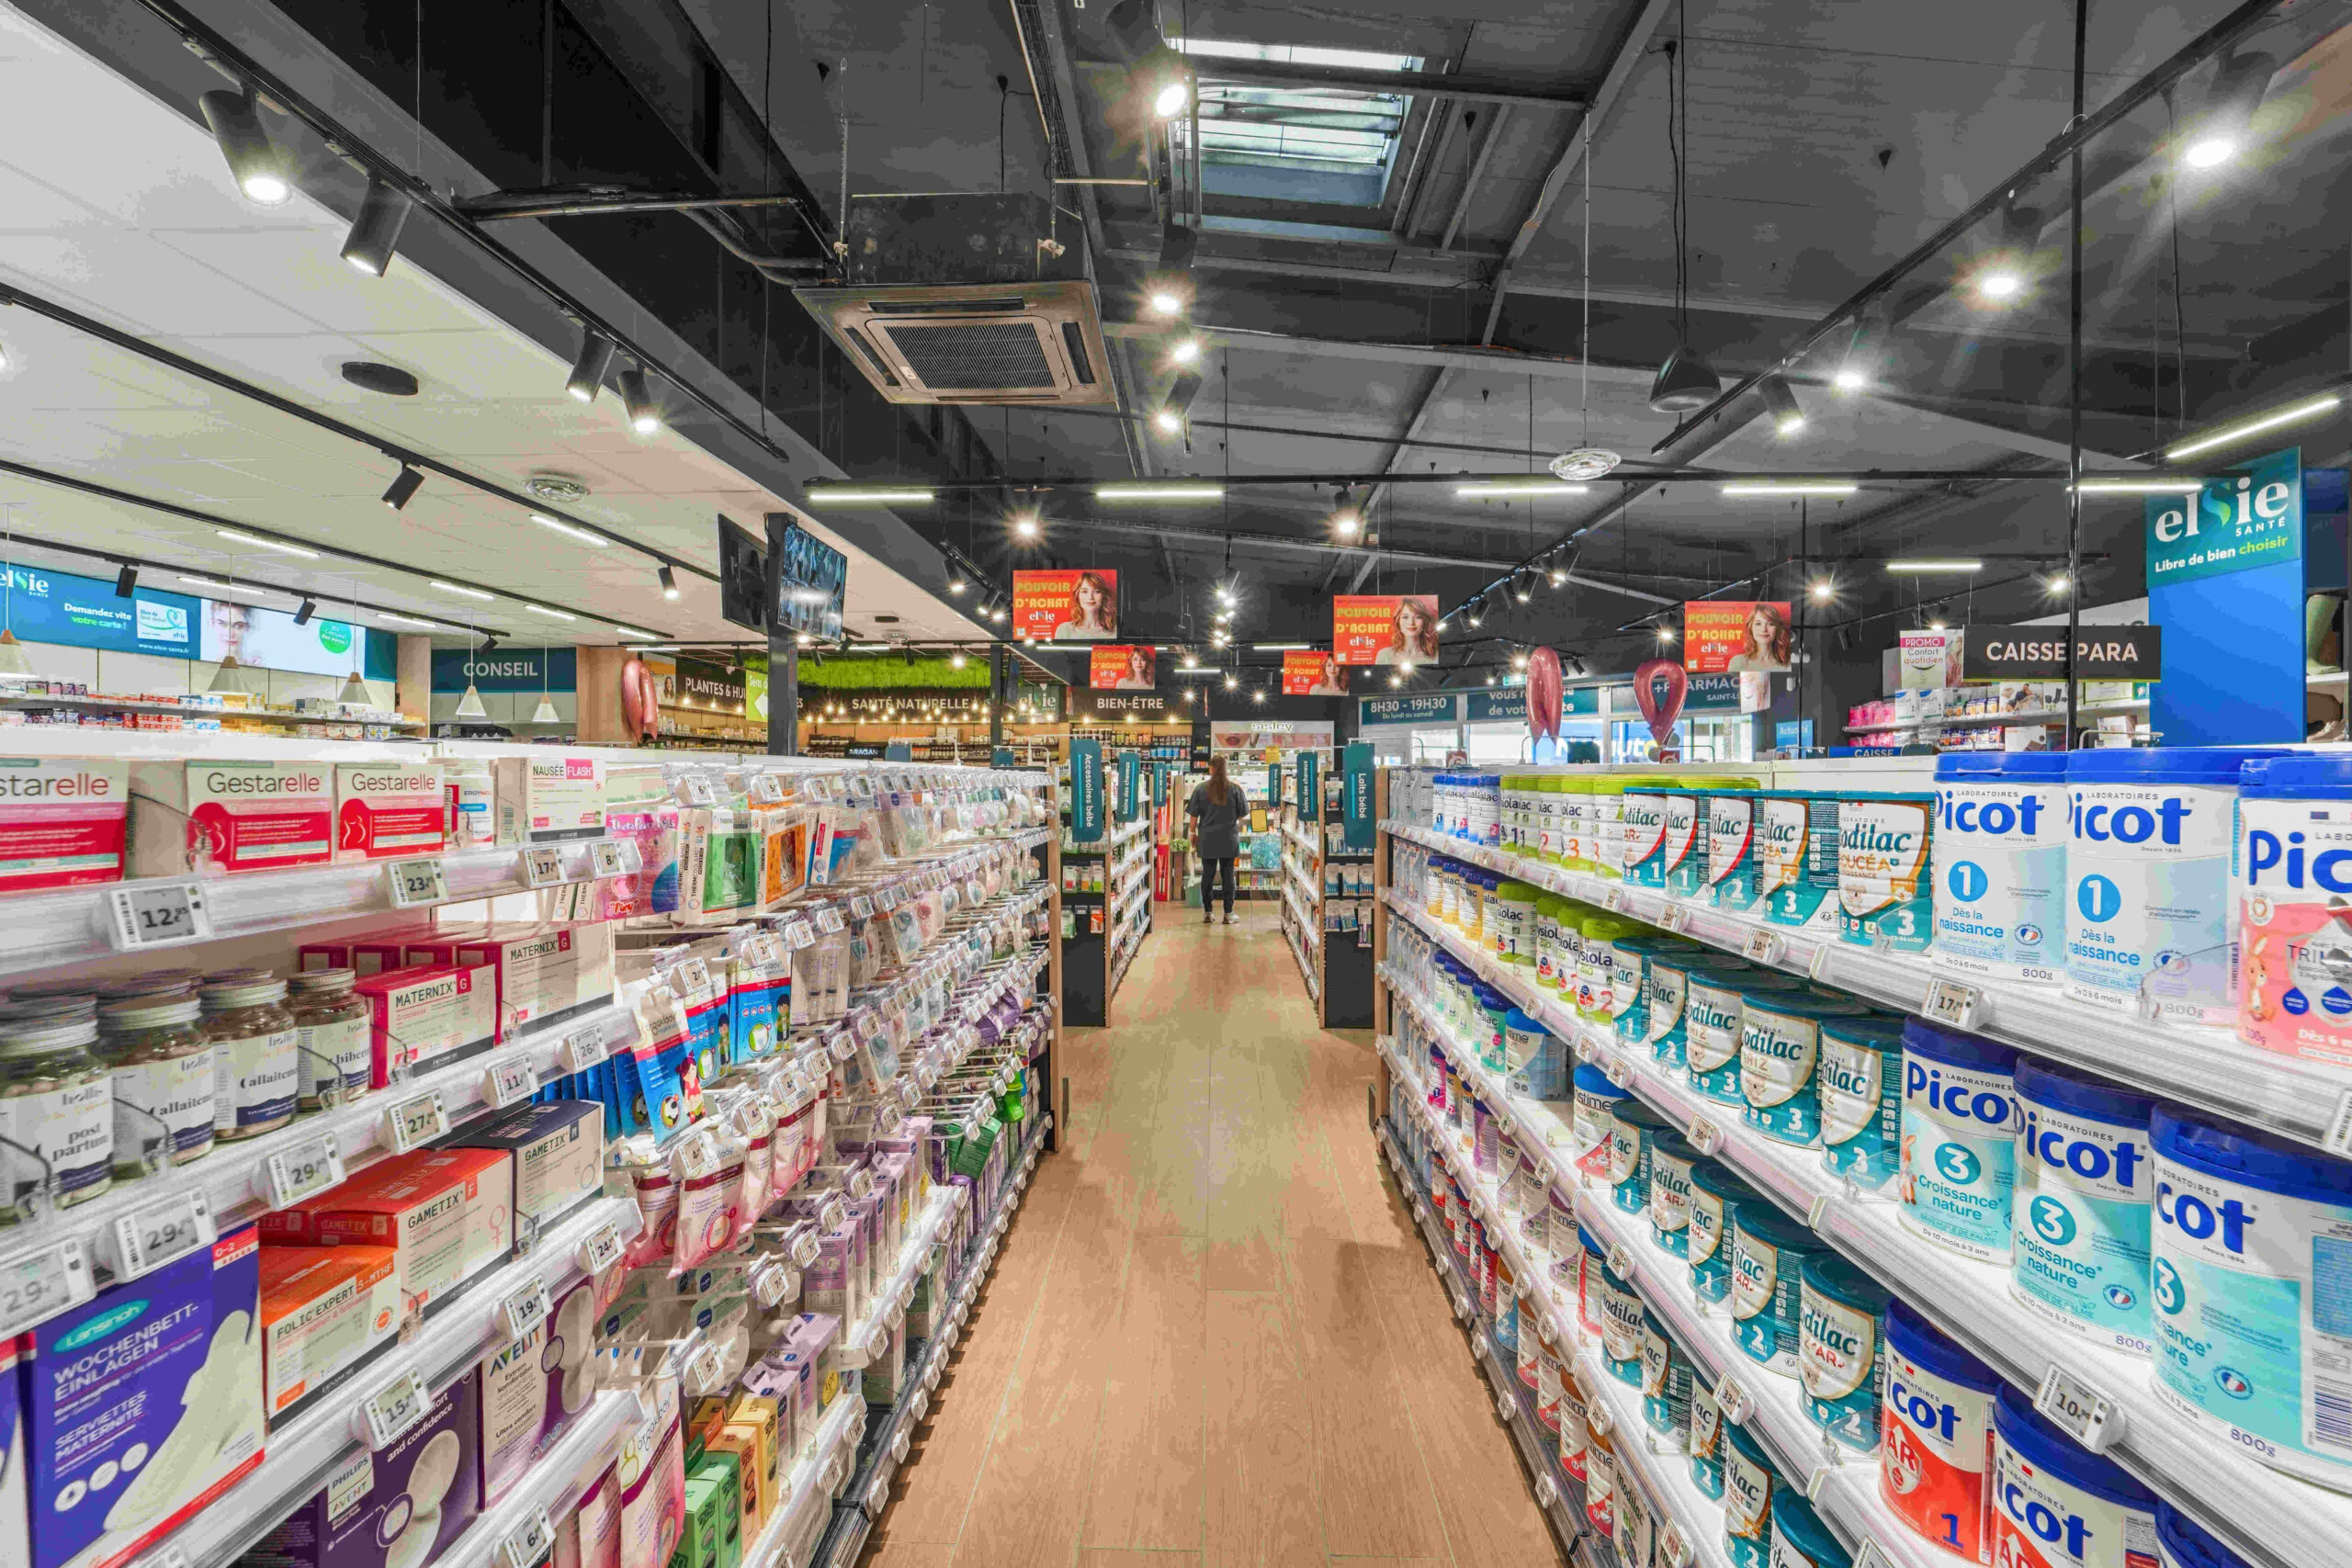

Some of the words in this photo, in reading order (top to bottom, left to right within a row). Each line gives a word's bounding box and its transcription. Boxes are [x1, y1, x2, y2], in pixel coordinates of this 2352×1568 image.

[2155, 477, 2289, 542] elsie
[2235, 516, 2286, 536] SANTÉ
[2155, 557, 2185, 573] Libre
[2188, 553, 2204, 566] de
[2208, 547, 2235, 562] bien
[2239, 536, 2288, 555] choisir
[1016, 581, 1070, 592] POUVOIR
[64, 603, 114, 617] Demandez
[114, 609, 131, 621] vite
[1015, 598, 1069, 608] D'ACHAT
[1337, 607, 1391, 618] POUVOIR
[72, 615, 97, 626] votre
[98, 619, 121, 629] carte
[1336, 623, 1391, 633] D'ACHAT
[1688, 614, 1743, 625] POUVOIR
[1687, 629, 1743, 640] D'ACHAT
[1905, 637, 1940, 648] PROMO
[1091, 651, 1126, 660] POUVOIR
[1904, 656, 1943, 666] quotidien
[1907, 648, 1939, 657] Confort
[1986, 642, 2065, 661] CAISSE
[2076, 643, 2139, 661] PARA
[463, 661, 538, 677] CONSEIL
[1091, 661, 1126, 670] D'ACHAT
[684, 677, 723, 696] PLANTES
[724, 683, 732, 697] &
[1489, 692, 1516, 700] vous
[852, 695, 893, 711] SANTÉ
[896, 698, 969, 711] NATURELLE
[1097, 696, 1164, 709] BIEN-ÊTRE
[1371, 700, 1399, 713] 8H30
[1409, 697, 1447, 710] 19H30
[1488, 705, 1503, 716] de
[1251, 721, 1293, 733] sisley
[1854, 749, 1894, 758] CAISSE
[533, 763, 564, 777] NAUSÉE
[567, 766, 592, 777] FLASH
[1085, 753, 1093, 804] Accessoires
[208, 773, 320, 794] Gestarelle
[352, 773, 435, 791] Gestarelle
[1359, 773, 1367, 795] Laits
[2086, 792, 2159, 800] LABORATOIRES
[1086, 806, 1094, 828] bébé
[1359, 796, 1367, 818] bébé
[2067, 793, 2193, 845] icot
[1540, 833, 1549, 852] 2
[1568, 838, 1580, 860] 3
[1651, 863, 1660, 878] 1
[1838, 853, 1891, 873] OUCÉA
[1959, 865, 1971, 897] 1
[1784, 890, 1796, 912] 3
[2087, 879, 2101, 916] 1
[1896, 910, 1915, 935] 3
[1952, 907, 1971, 920] Dès
[1973, 909, 1984, 920] la
[1939, 919, 2004, 940] naissance
[2082, 928, 2101, 942] Dès
[2103, 930, 2116, 944] la
[511, 940, 558, 961] MATERNIX
[560, 936, 568, 948] G
[1510, 939, 1516, 955] 1
[1970, 964, 1989, 972] mois
[2021, 967, 2053, 981] 800g
[395, 981, 454, 1009] MATERNIX
[459, 977, 468, 991] G
[1600, 990, 1612, 1013] 2
[2101, 995, 2122, 1005] mois
[2164, 1005, 2205, 1020] 800g
[1724, 1071, 1736, 1092] 3
[1906, 1060, 2017, 1124] Pico
[1946, 1073, 2012, 1091] LABORATOIRES
[1789, 1108, 1803, 1131] 3
[2041, 1115, 2114, 1143] LABORATOIRES
[68, 1123, 102, 1145] post
[52, 1135, 109, 1160] partum
[525, 1134, 566, 1161] GAMETIX
[1941, 1146, 1971, 1179] 3
[1624, 1189, 1633, 1203] 1
[408, 1191, 459, 1229] GAMETIX
[468, 1185, 475, 1198] F
[1933, 1195, 1983, 1222] nature
[322, 1220, 368, 1233] GAMETIX
[2037, 1200, 2066, 1240] 3
[1923, 1228, 1931, 1236] De
[1932, 1232, 1940, 1240] 10
[1941, 1235, 1961, 1250] mois
[1974, 1248, 1990, 1258] ans
[2028, 1257, 2078, 1290] nature
[2156, 1262, 2176, 1307] 3
[277, 1309, 312, 1339] FOLIC
[315, 1285, 355, 1314] EXPERT
[2028, 1298, 2036, 1307] 10
[2036, 1303, 2054, 1318] mois
[2069, 1321, 2086, 1332] ans
[66, 1305, 140, 1348] Lansinoh
[54, 1302, 199, 1384] WOCHENBETT-
[1753, 1325, 1765, 1351] 2
[489, 1325, 540, 1378] AVENT
[55, 1337, 159, 1402] EINLAGEN
[504, 1362, 526, 1382] Extrem
[55, 1391, 148, 1449] SERVIETTES
[514, 1404, 537, 1425] comfort
[387, 1444, 406, 1462] and
[407, 1403, 453, 1454] confidence
[2231, 1427, 2276, 1458] 800g
[1885, 1433, 1916, 1472] AR
[332, 1456, 368, 1490] PHILIPS
[1702, 1464, 1713, 1486] 2
[333, 1480, 368, 1515] AVENT
[1940, 1513, 1964, 1548] 1
